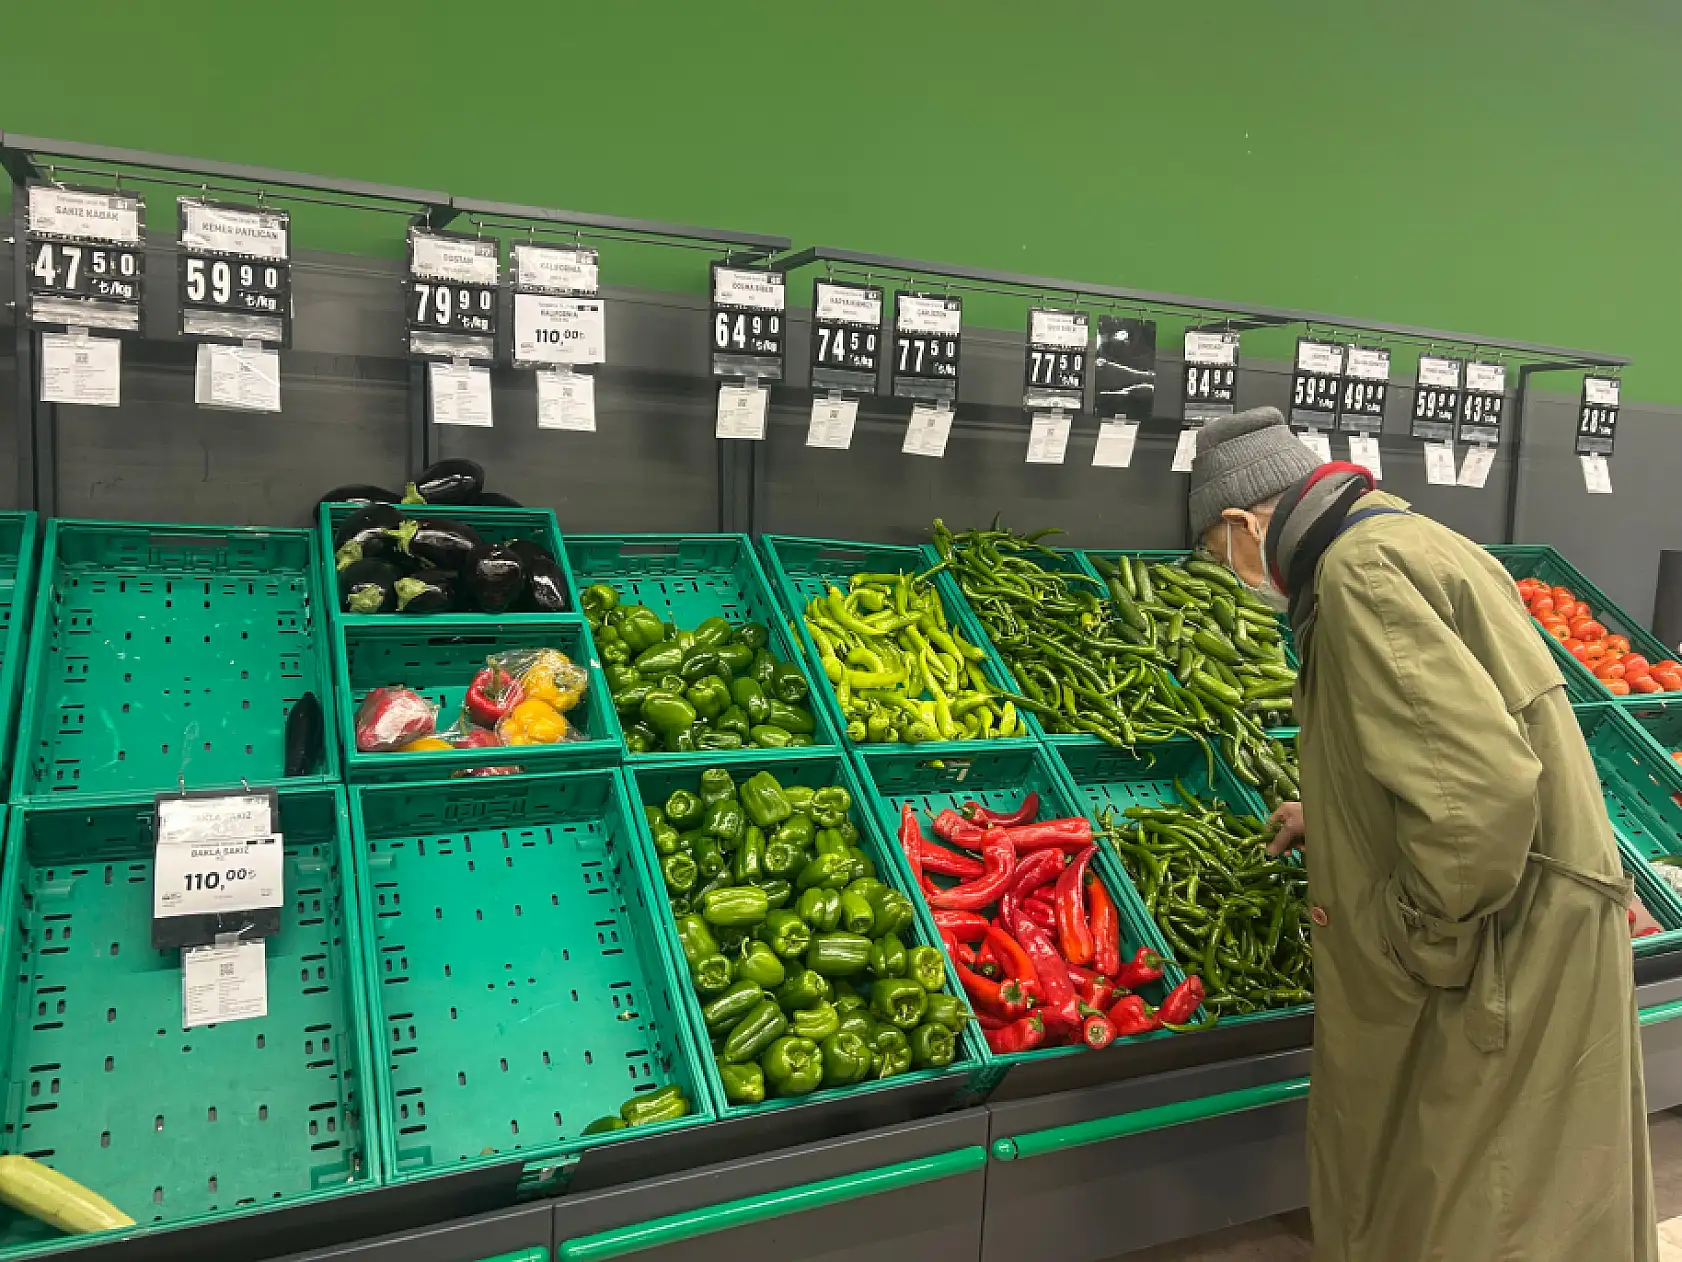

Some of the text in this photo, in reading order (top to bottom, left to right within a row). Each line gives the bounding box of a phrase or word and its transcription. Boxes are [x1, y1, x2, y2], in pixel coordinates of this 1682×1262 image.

[34, 243, 134, 290] 47 50
[187, 258, 278, 304] 59 90
[414, 283, 491, 325] 79 90
[715, 312, 780, 349] 64 90
[818, 328, 877, 362] 74 50
[898, 339, 925, 373] 77
[1031, 352, 1056, 384] 77
[1187, 367, 1210, 398] 84
[1295, 376, 1317, 406] 59
[1344, 383, 1365, 411] 49
[1416, 390, 1437, 418] 59
[1464, 394, 1483, 423] 43
